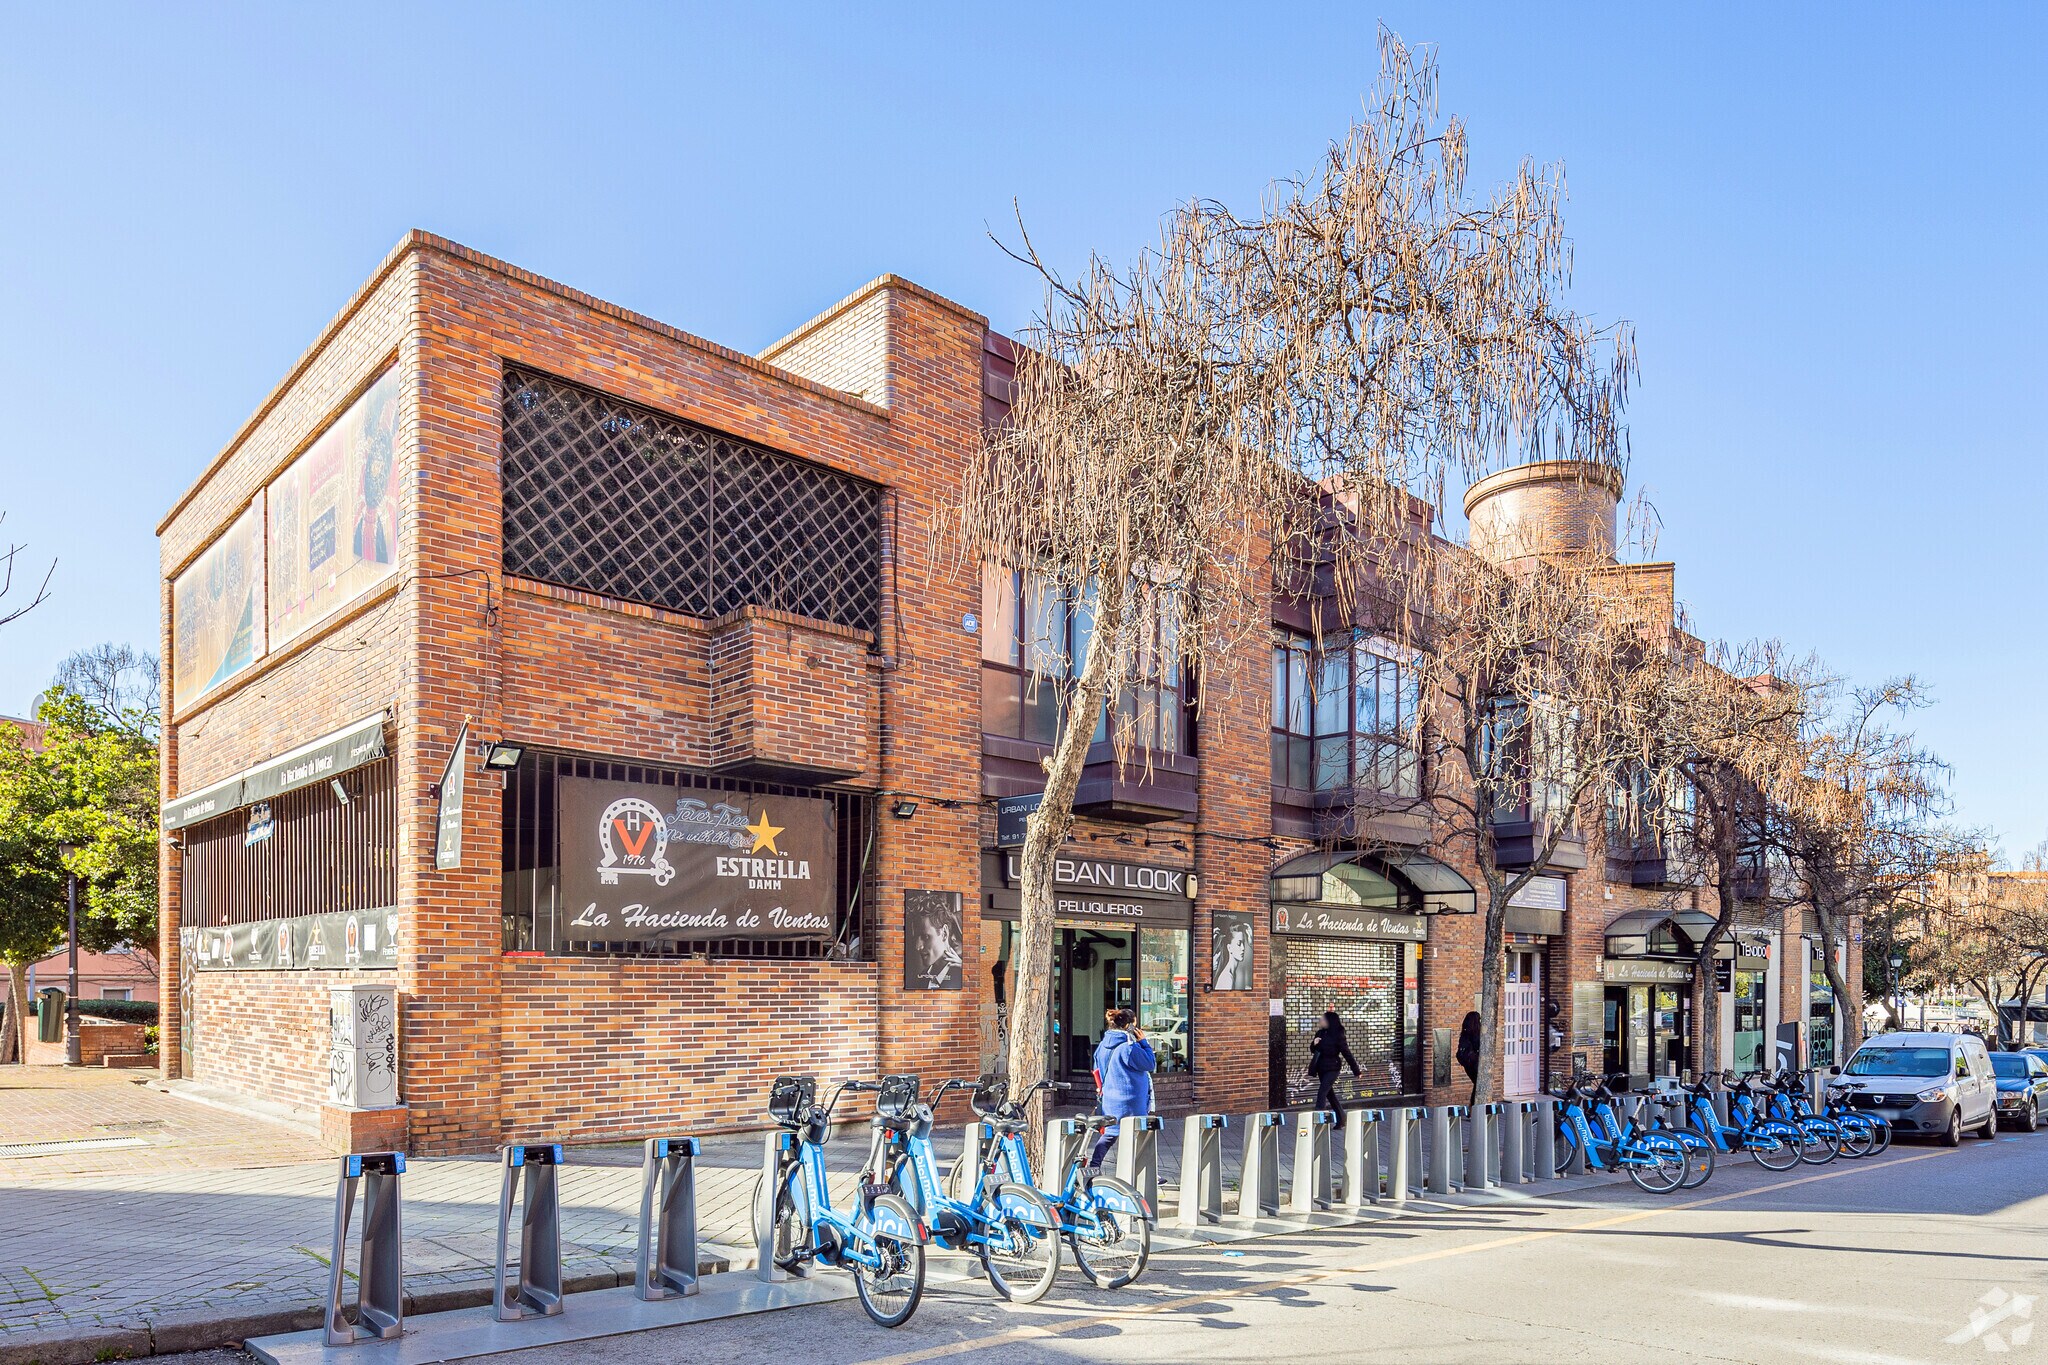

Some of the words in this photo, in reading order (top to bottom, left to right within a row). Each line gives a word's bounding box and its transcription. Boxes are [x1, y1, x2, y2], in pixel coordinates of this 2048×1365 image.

[666, 798, 750, 828] Fever-Tree
[1001, 803, 1027, 815] URBAN
[1030, 803, 1041, 811] LO
[626, 811, 641, 832] H
[611, 818, 656, 856] V
[686, 828, 711, 843] with
[711, 829, 730, 844] the
[622, 854, 646, 866] 1976
[716, 856, 811, 880] ESTRELLA
[748, 878, 782, 890] DAMM
[1009, 856, 1115, 886] UBAN
[1124, 866, 1182, 893] LOOK
[570, 902, 611, 927] La
[620, 903, 729, 929] Hacienda
[735, 908, 761, 928] de
[767, 906, 831, 930] Ventas
[1058, 900, 1144, 916] PELUQUEROS
[1296, 912, 1314, 929] La
[1317, 913, 1365, 933] Hacienda
[1366, 920, 1379, 932] de
[1380, 917, 1410, 935] Ventas
[1603, 1113, 1617, 1139] bicima
[1008, 1150, 1023, 1184] bicim
